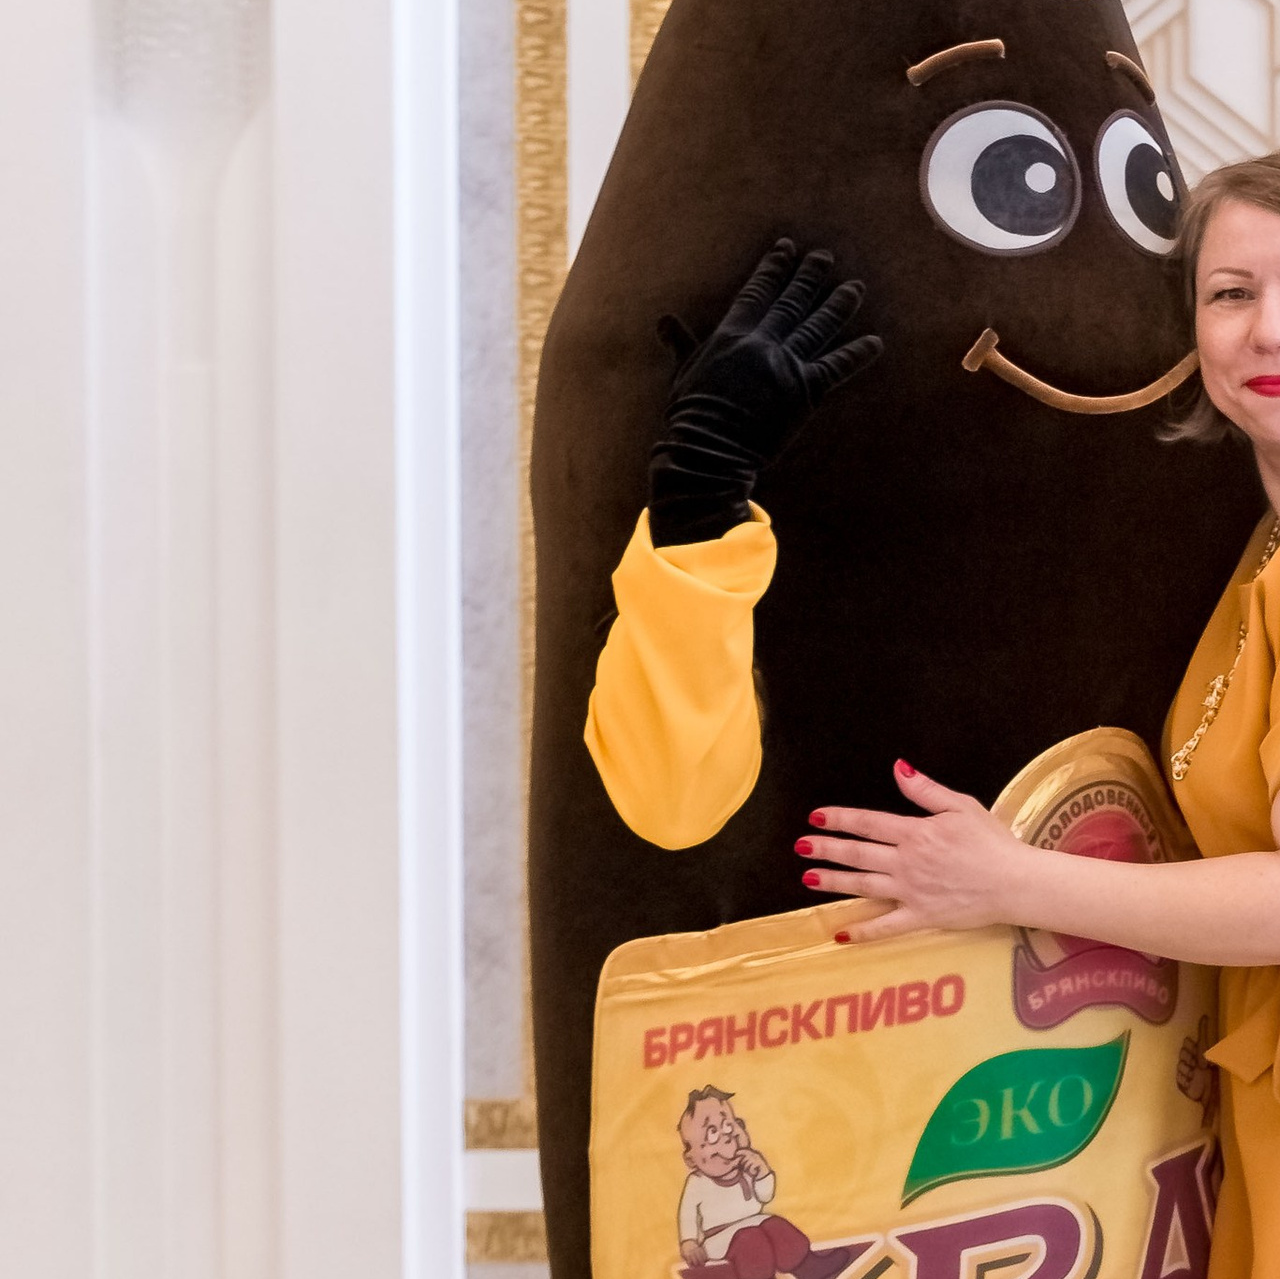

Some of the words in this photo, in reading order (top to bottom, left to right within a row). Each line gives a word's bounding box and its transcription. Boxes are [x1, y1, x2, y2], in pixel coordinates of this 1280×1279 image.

[643, 973, 966, 1070] БРЯНСКПИВО
[1027, 970, 1170, 1012] БРЯНСКПИВО
[950, 1074, 1094, 1149] ЭКО
